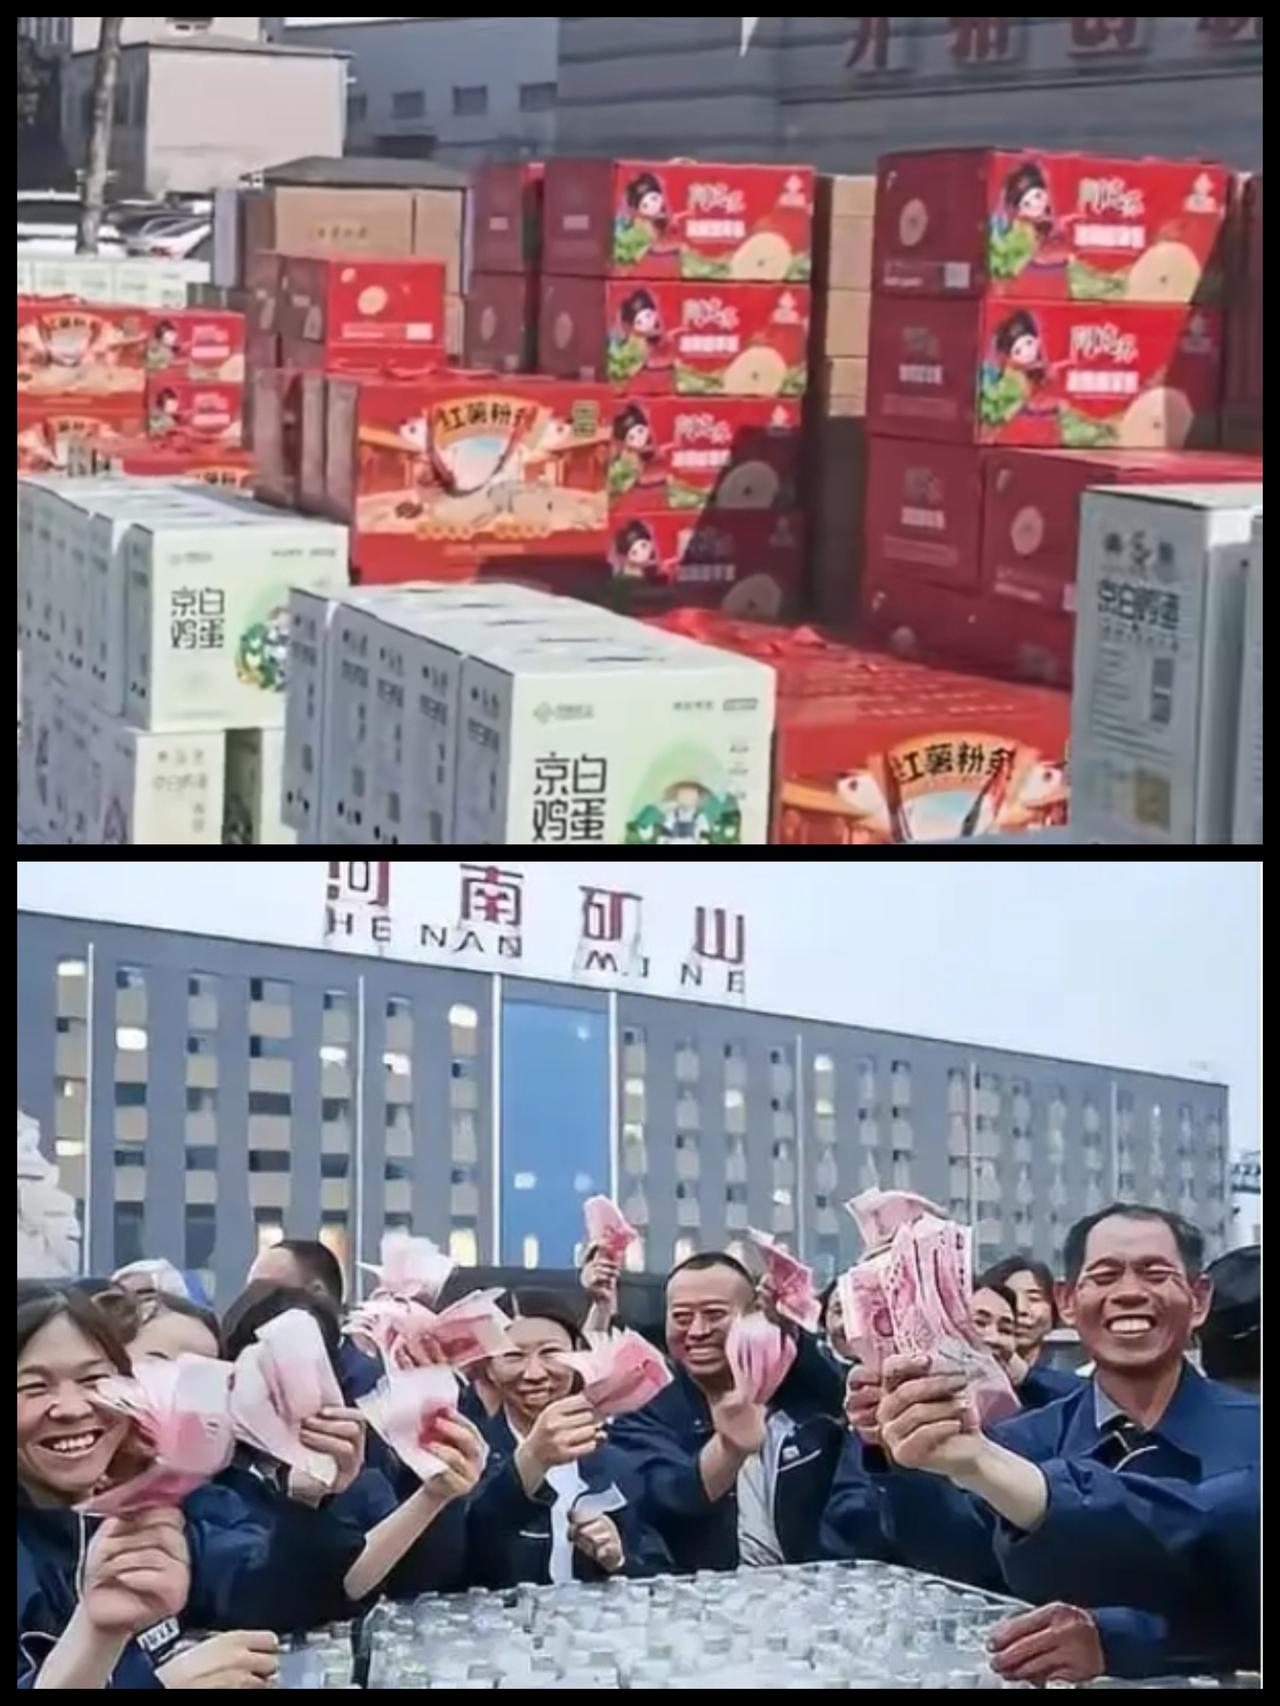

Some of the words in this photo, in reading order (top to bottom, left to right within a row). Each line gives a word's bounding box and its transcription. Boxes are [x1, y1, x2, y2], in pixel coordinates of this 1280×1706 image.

[171, 586, 225, 616] 京白
[171, 618, 225, 649] 鸡蛋
[533, 752, 607, 796] 京白
[532, 797, 607, 842] 鸡蛋
